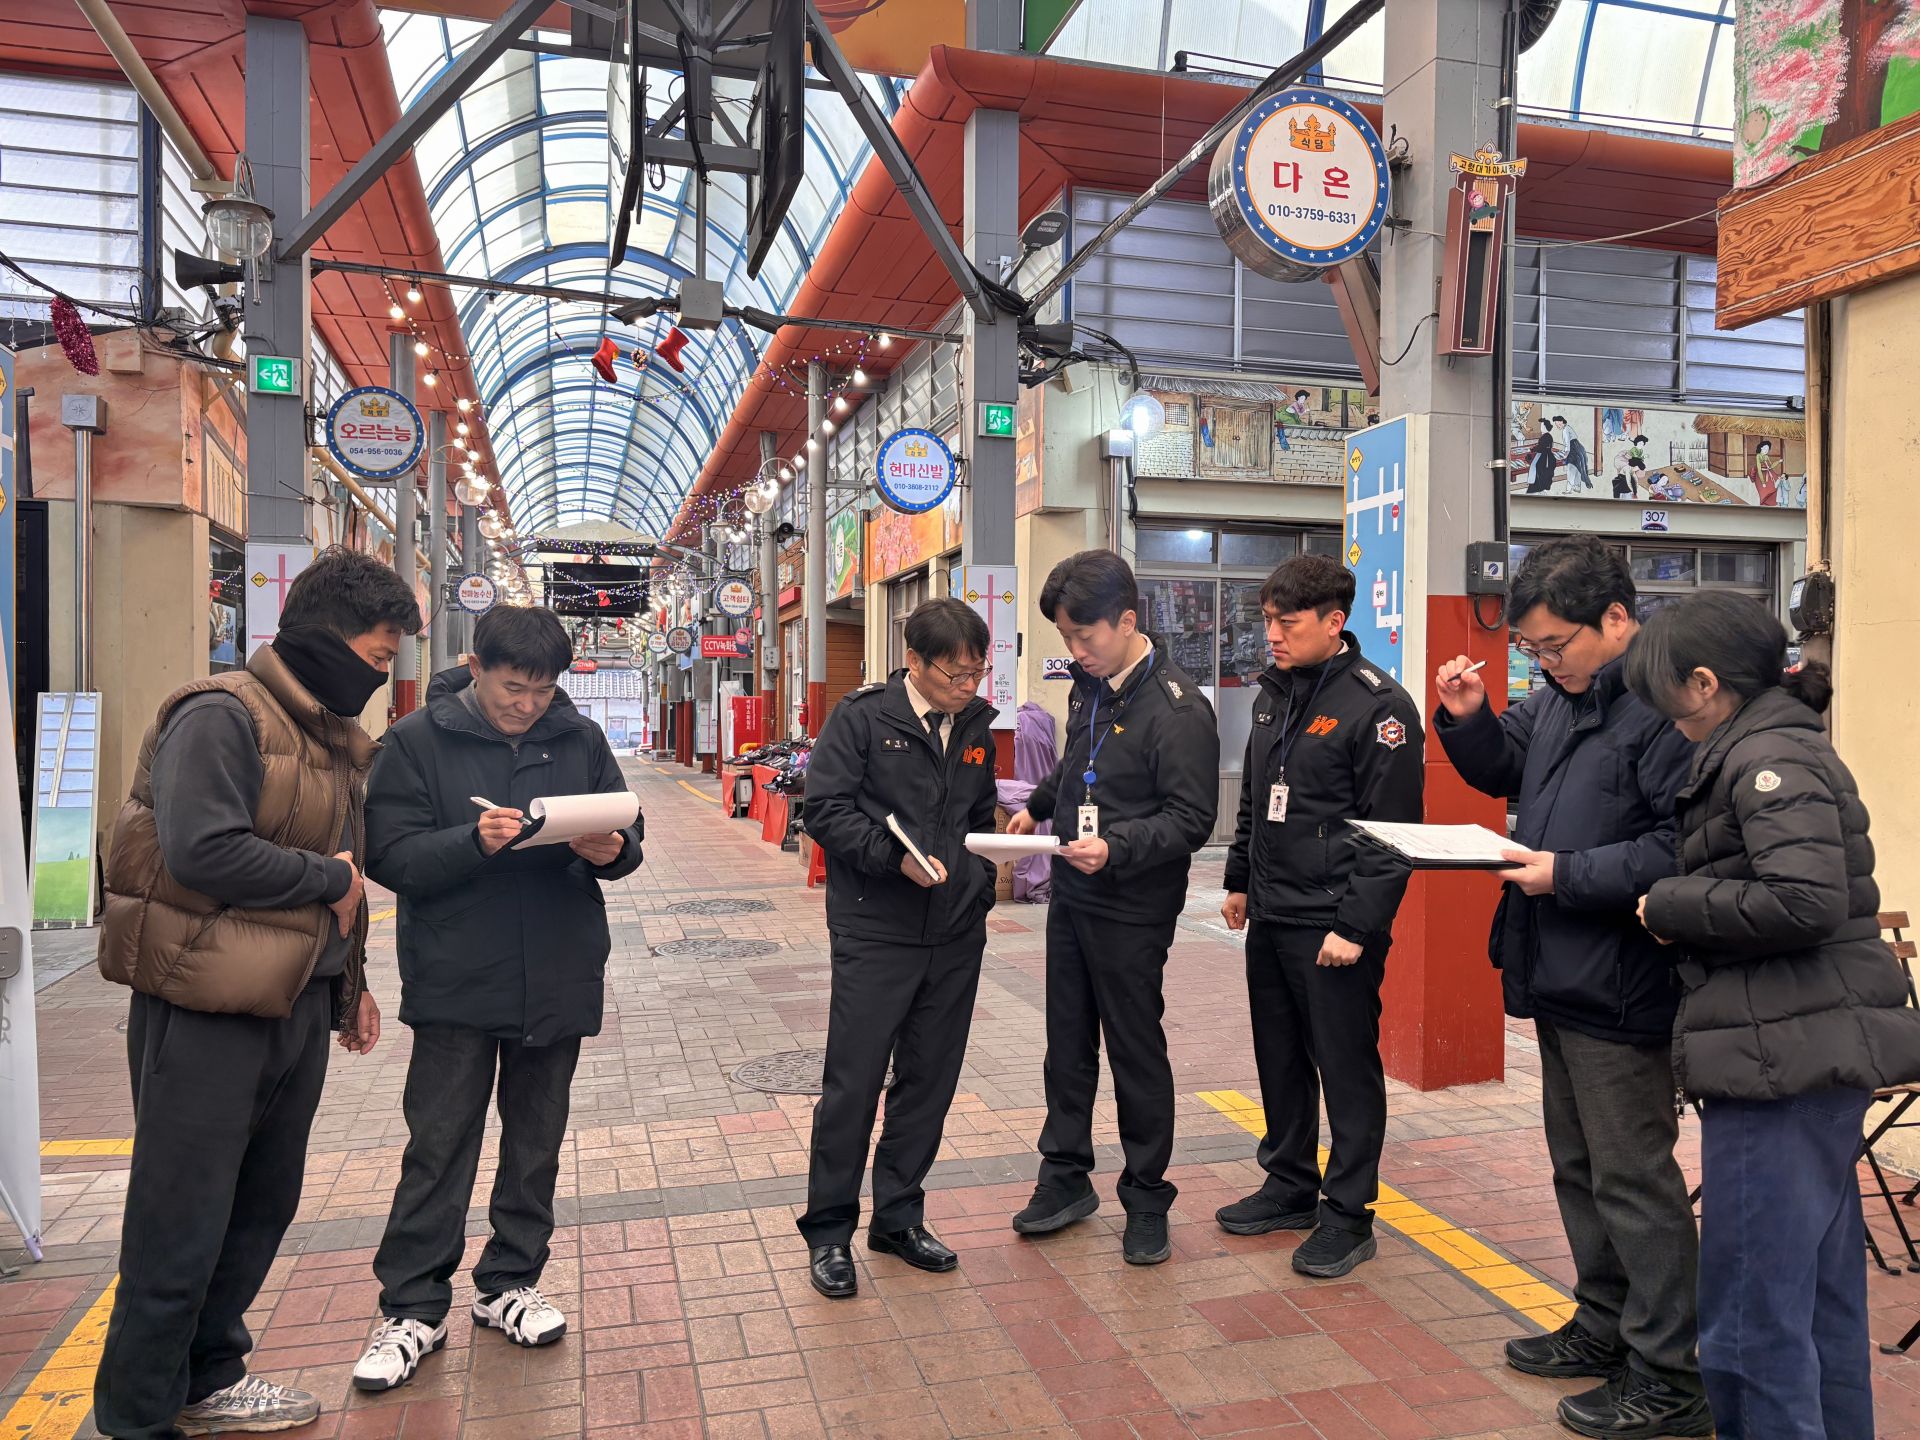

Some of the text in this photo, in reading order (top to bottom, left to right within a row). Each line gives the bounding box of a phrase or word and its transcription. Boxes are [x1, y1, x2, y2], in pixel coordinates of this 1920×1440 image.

[1302, 138, 1323, 150] 식당
[1268, 203, 1357, 225] 010-3759-6331
[340, 422, 412, 442] 오르는능
[889, 461, 944, 480] 현대신발
[1645, 511, 1666, 522] 307
[722, 594, 750, 604] 고객쉼터
[1046, 658, 1070, 670] 308
[1306, 718, 1338, 735] 119
[963, 747, 985, 764] 119
